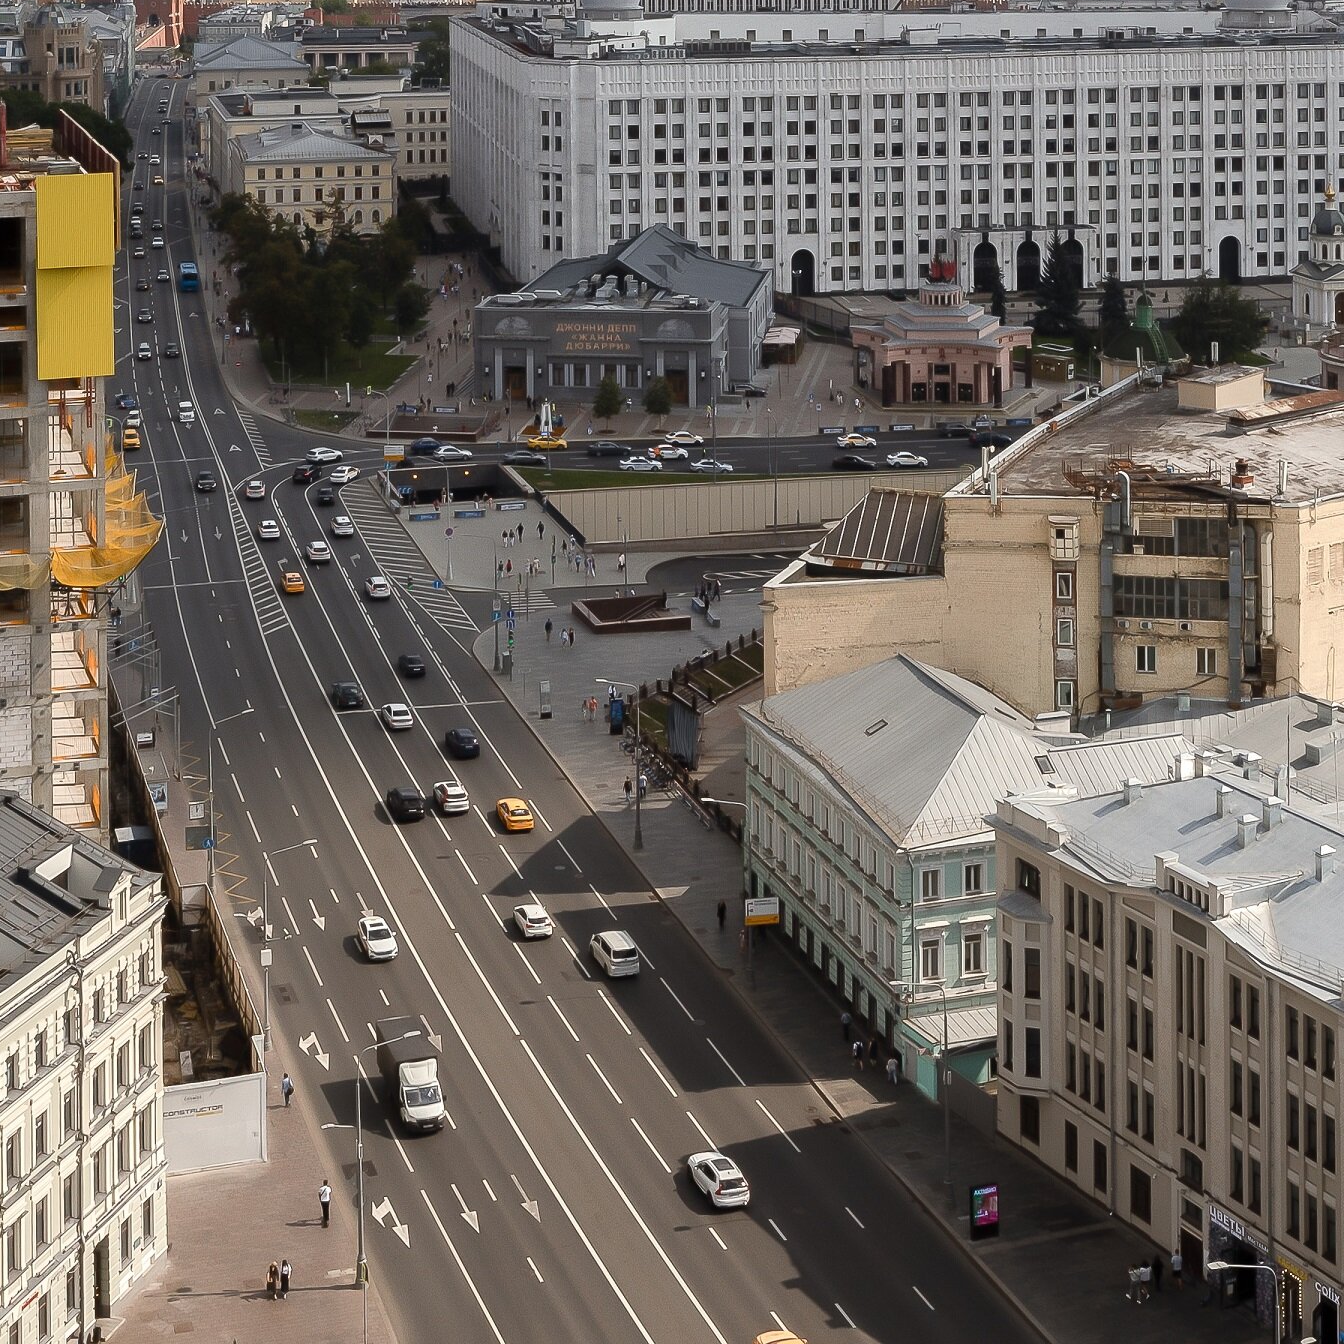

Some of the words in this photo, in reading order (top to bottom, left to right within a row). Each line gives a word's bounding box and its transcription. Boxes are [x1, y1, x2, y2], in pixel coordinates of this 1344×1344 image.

[556, 323, 604, 332] ДЖОННИ
[607, 324, 636, 333] ДЕПП
[565, 342, 631, 351] ДЮБАРРИ»
[1209, 1205, 1245, 1237] ЦВЕТЫ
